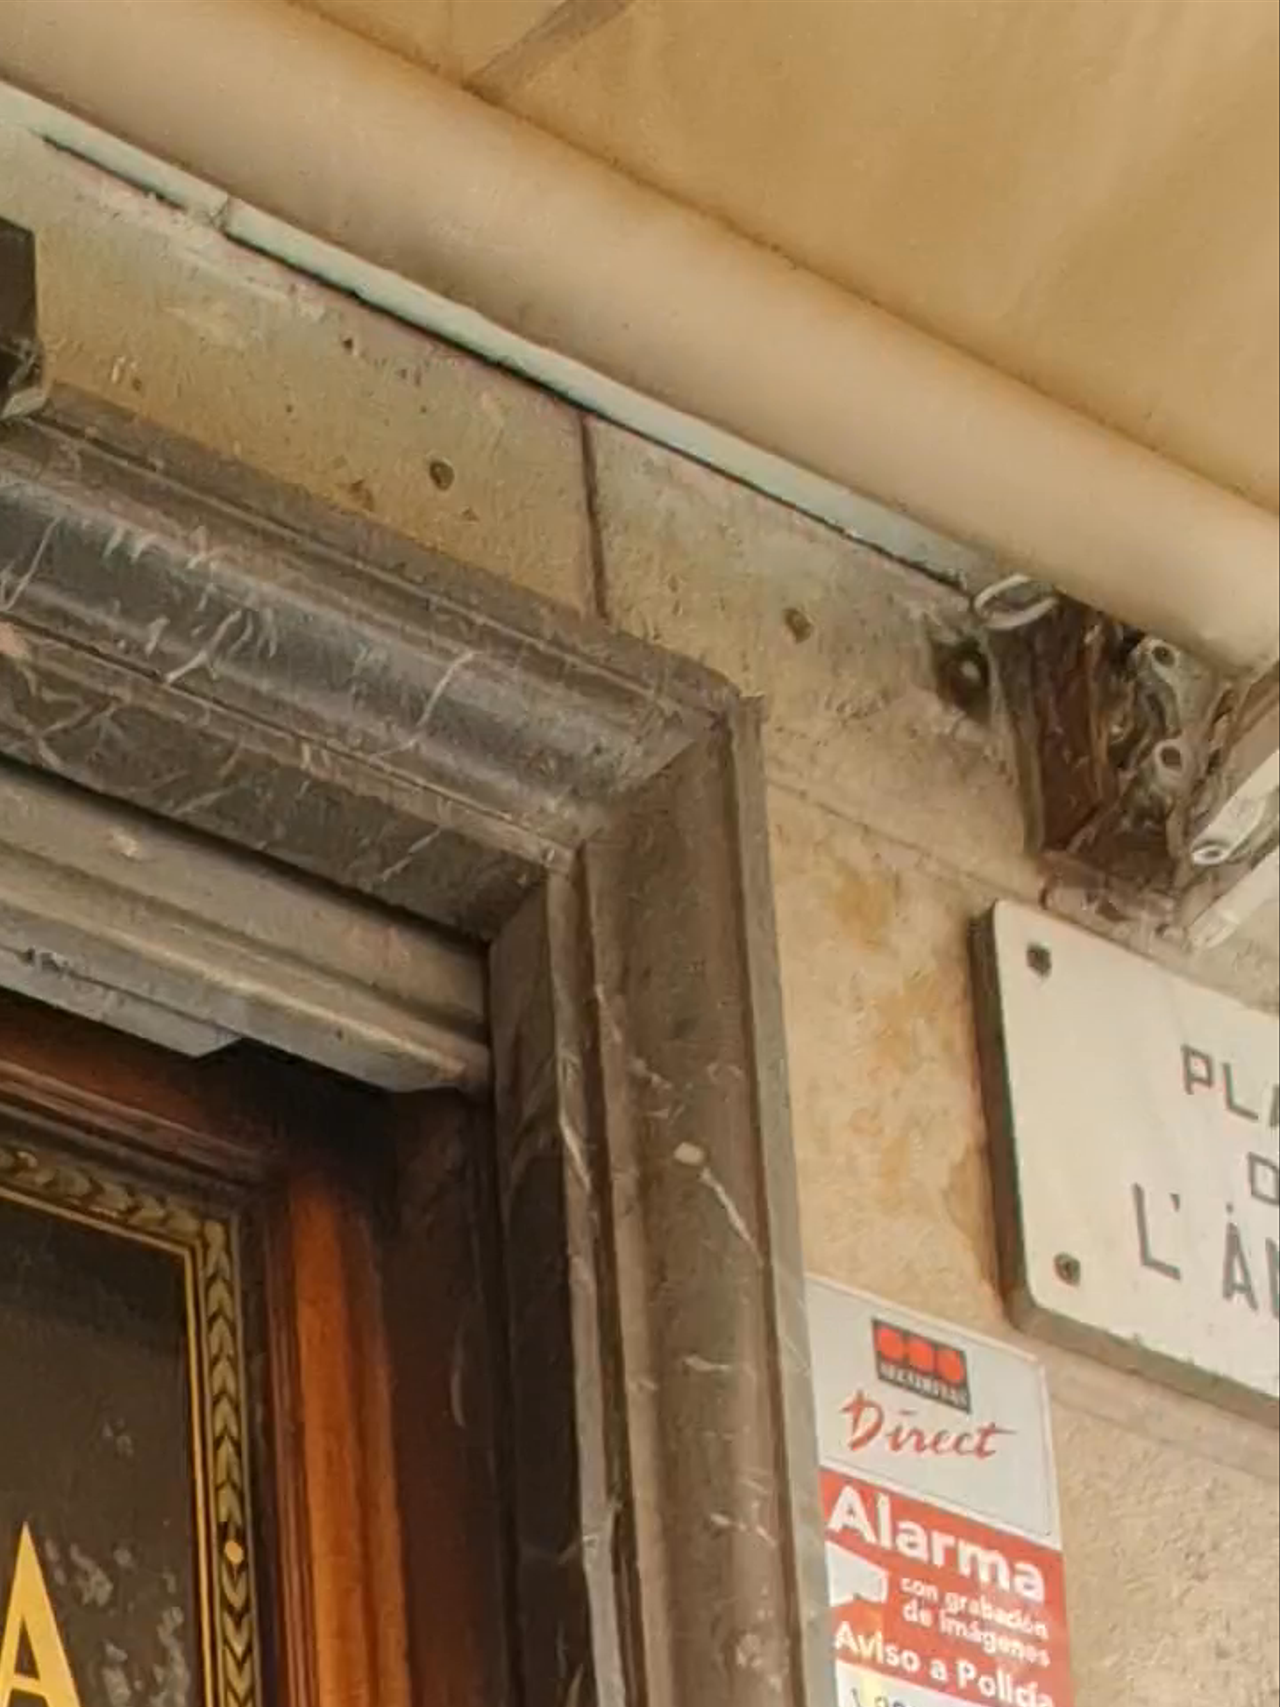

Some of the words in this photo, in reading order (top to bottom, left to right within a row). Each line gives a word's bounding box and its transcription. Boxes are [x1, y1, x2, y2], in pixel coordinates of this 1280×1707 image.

[840, 1388, 1017, 1459] Direct
[826, 1484, 1045, 1602] Alarma
[900, 1577, 938, 1602] con
[902, 1599, 933, 1628] de
[834, 1620, 921, 1672] Aviso
[929, 1657, 948, 1682] a
